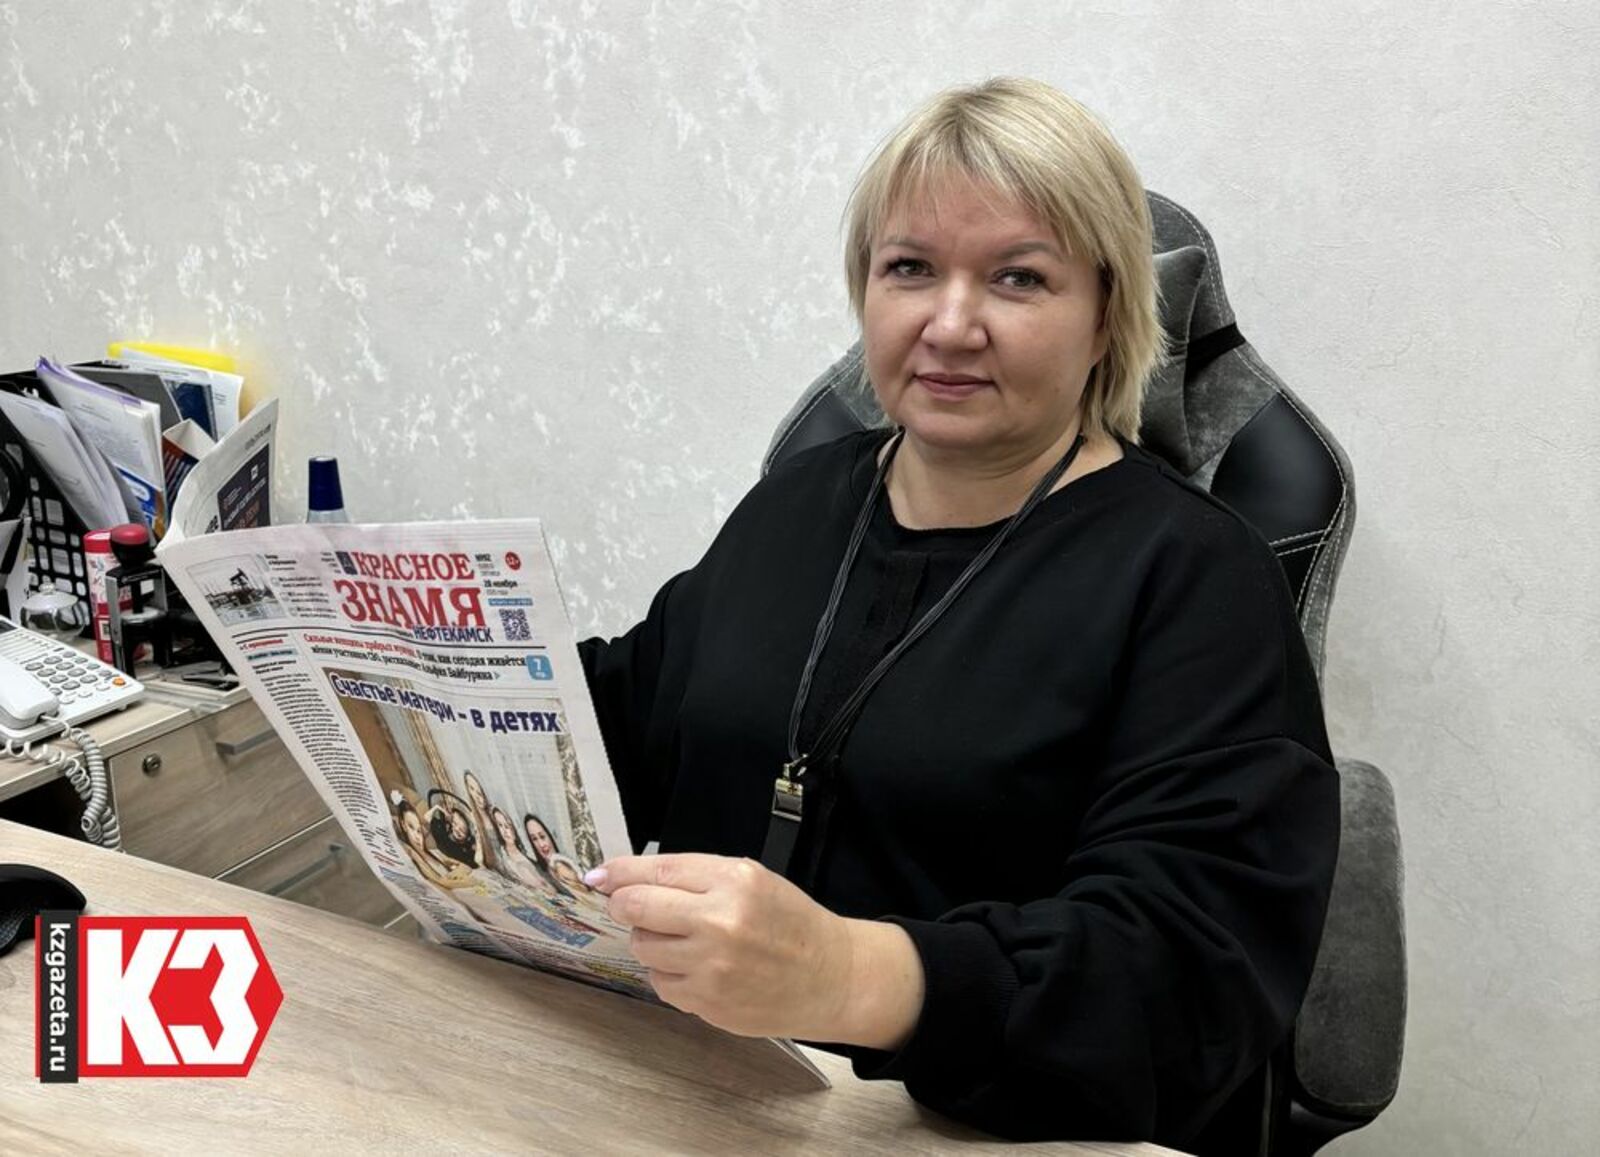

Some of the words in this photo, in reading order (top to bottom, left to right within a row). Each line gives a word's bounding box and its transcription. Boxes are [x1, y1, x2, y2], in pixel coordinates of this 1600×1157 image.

[351, 551, 475, 581] КРАСНОЕ
[334, 579, 487, 629] ЗНАМЯ
[413, 625, 493, 642] НЕФТЕКАМСК
[453, 656, 485, 667] сегодня
[331, 674, 398, 704] Счастье
[398, 688, 455, 723] матери
[470, 708, 486, 728] в
[489, 709, 561, 733] детях
